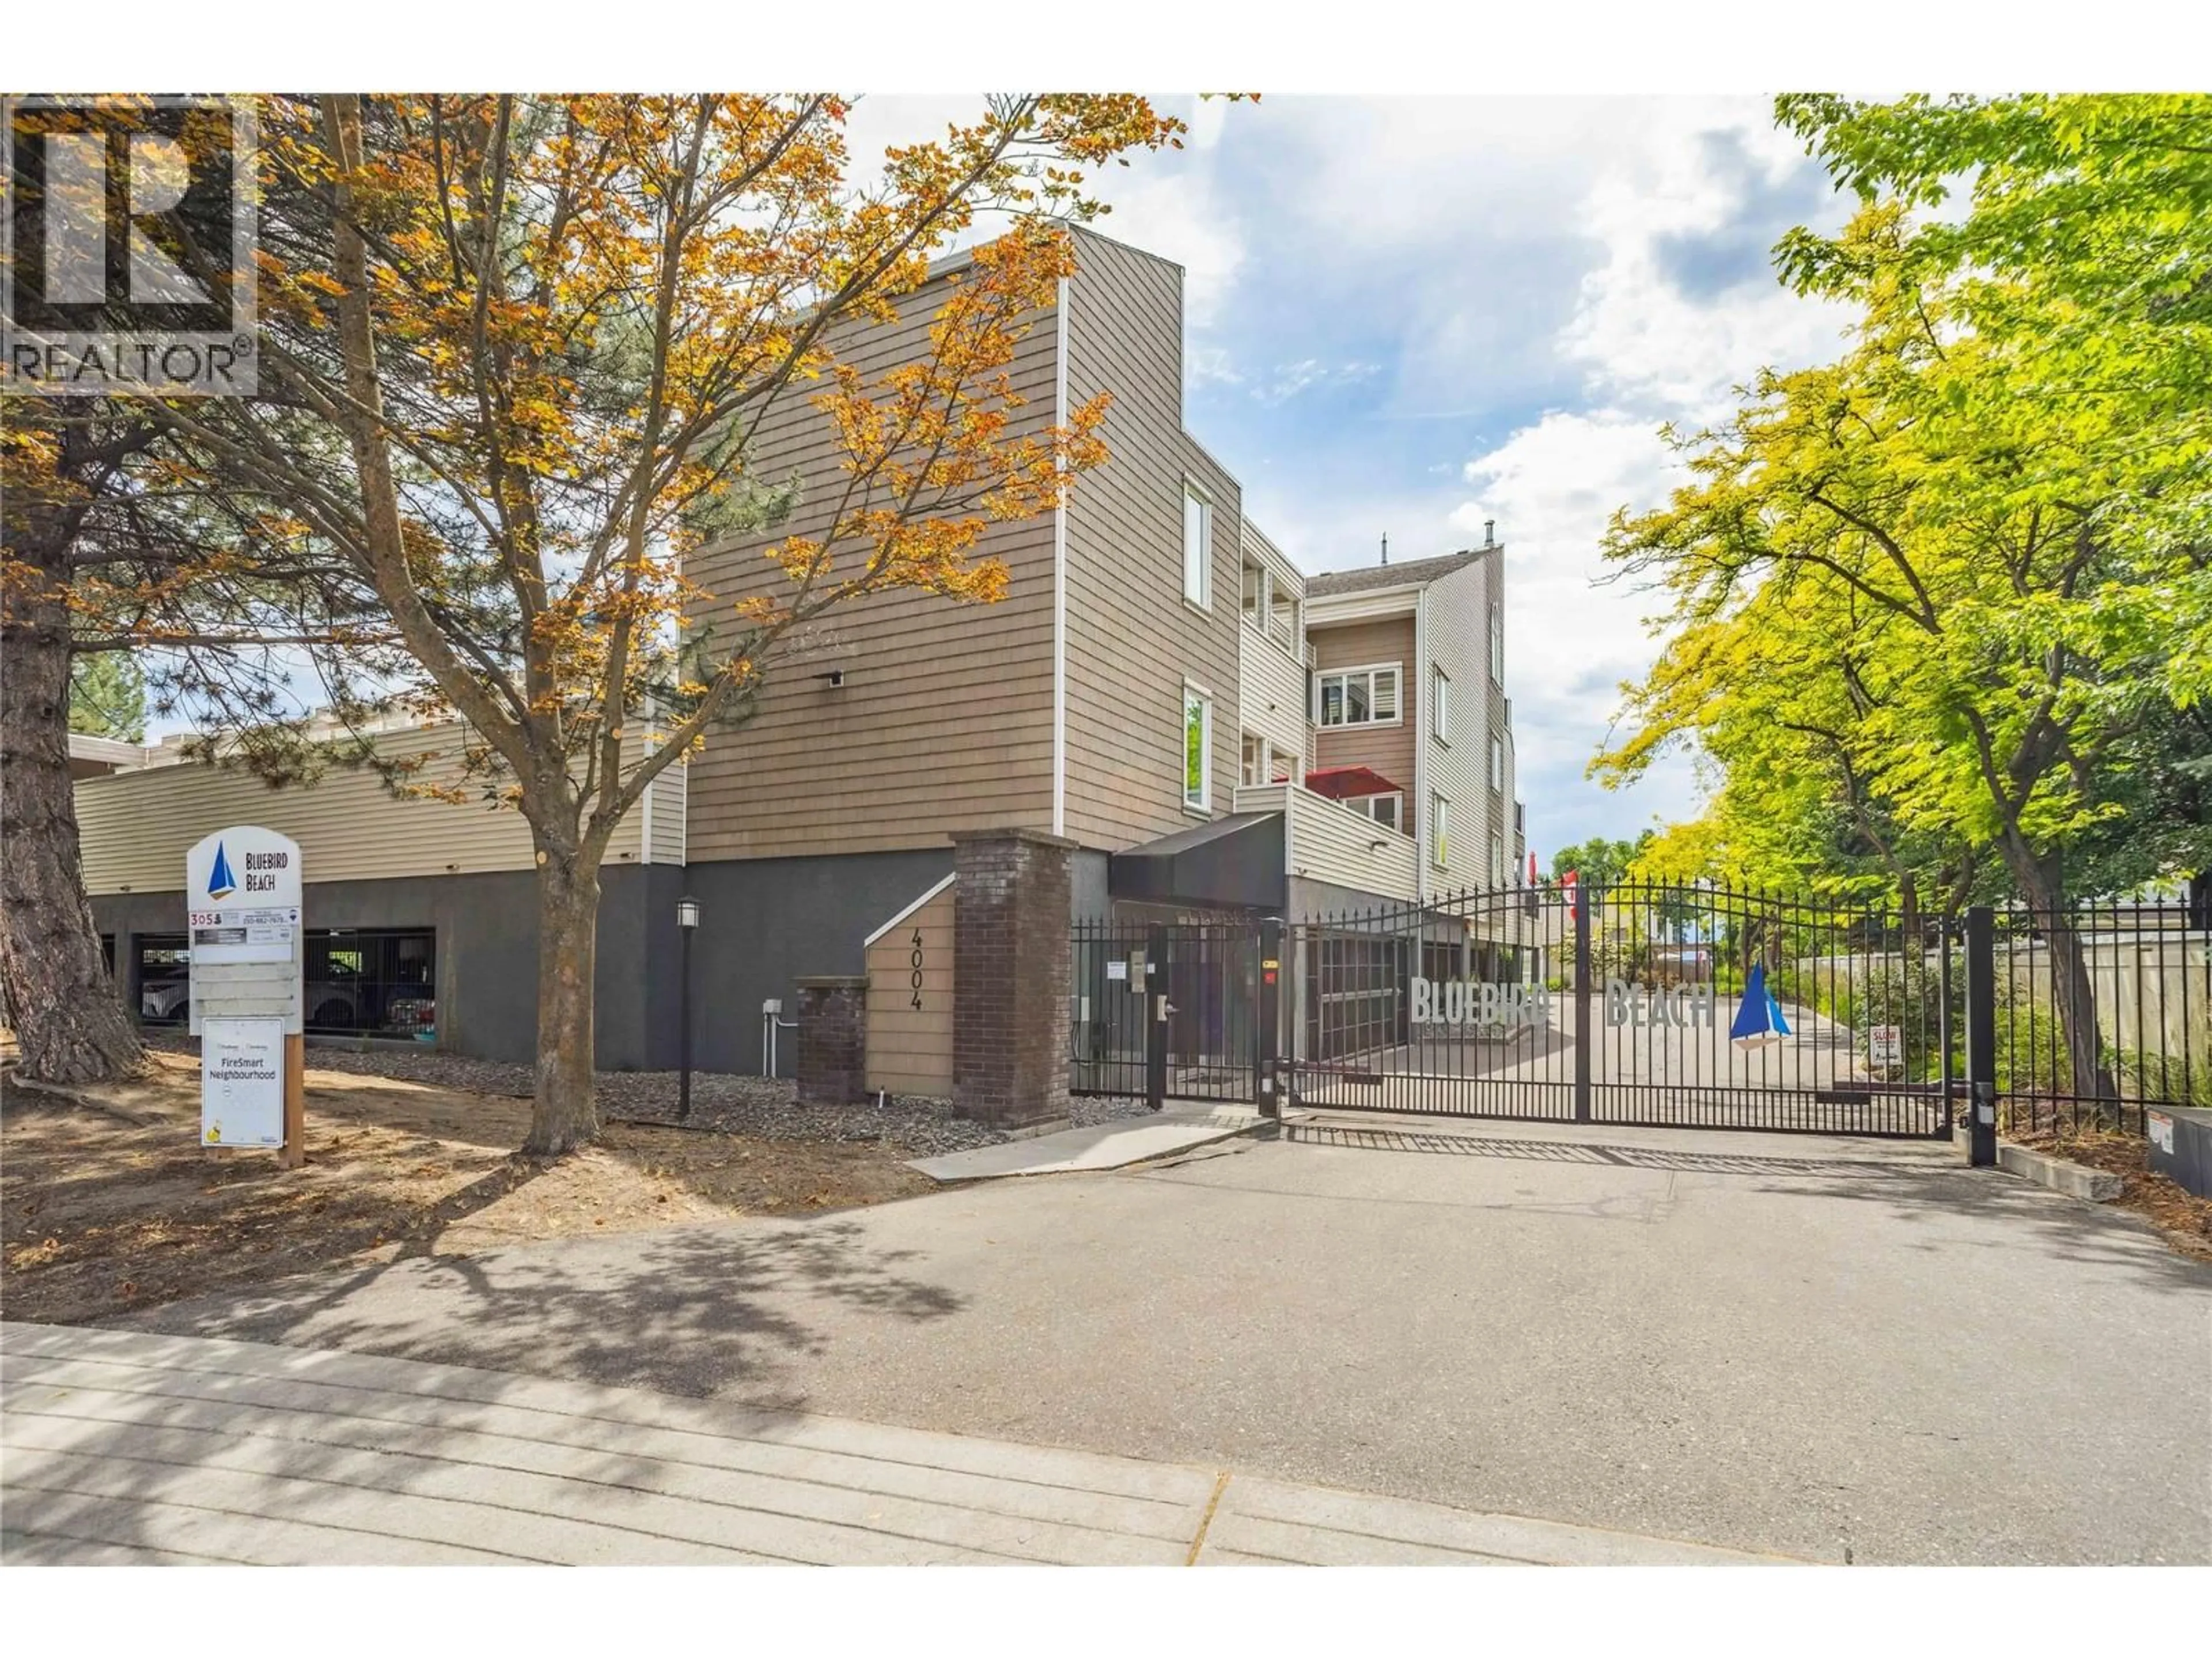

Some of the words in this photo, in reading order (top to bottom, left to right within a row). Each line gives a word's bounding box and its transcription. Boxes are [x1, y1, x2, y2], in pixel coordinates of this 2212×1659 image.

[246, 853, 289, 870] BLUEBIRD
[246, 873, 275, 891] BEACH
[911, 927, 923, 1010] 4004
[1411, 977, 1550, 1024] BLUEBIRD
[1605, 980, 1713, 1028] BEACH
[221, 1058, 264, 1067] FireSmart
[210, 1070, 276, 1081] Neighbourhood
